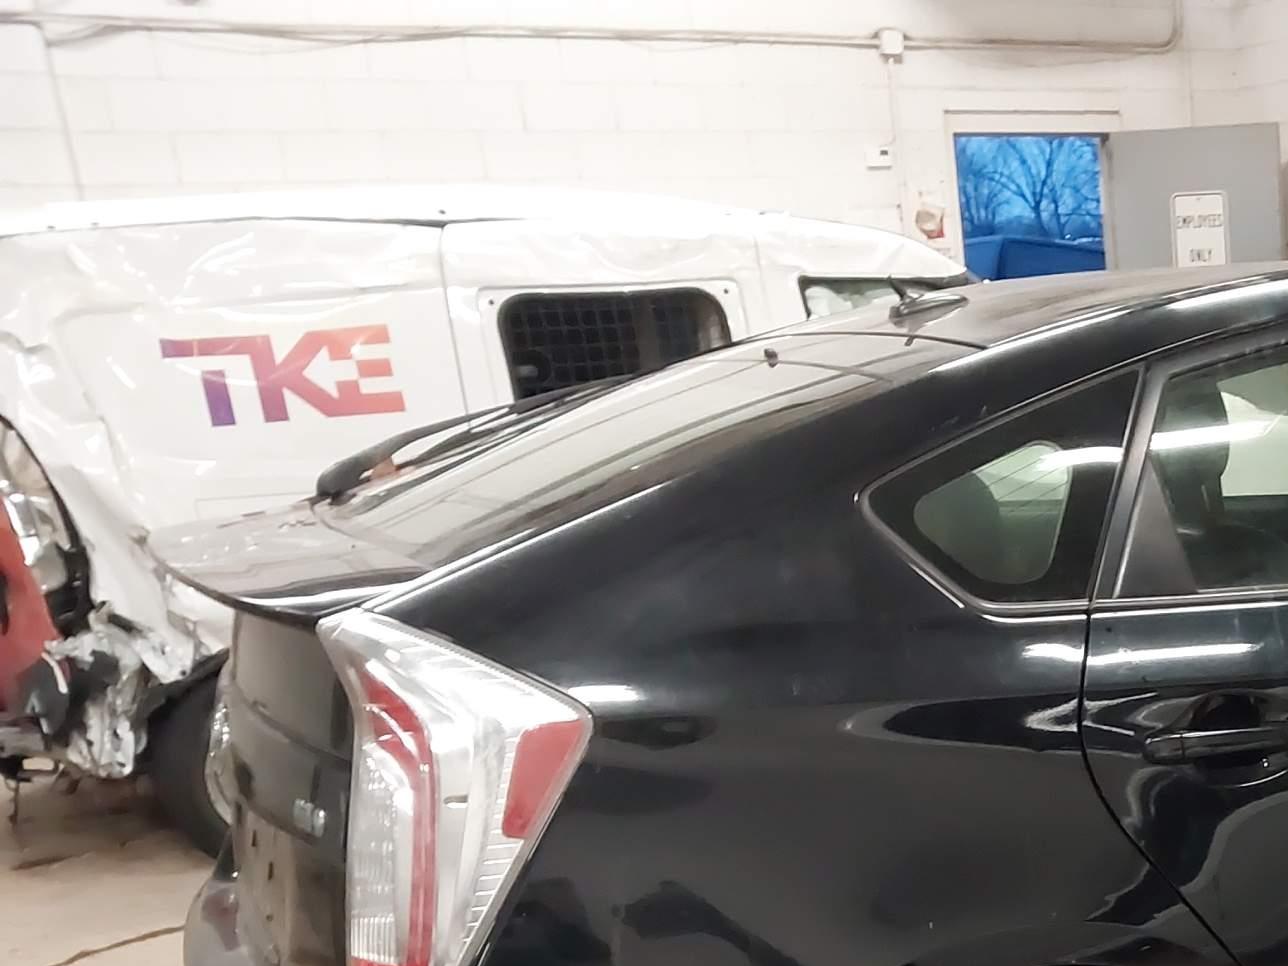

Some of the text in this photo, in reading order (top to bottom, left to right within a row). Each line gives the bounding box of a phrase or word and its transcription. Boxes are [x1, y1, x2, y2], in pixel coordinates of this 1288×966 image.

[1175, 213, 1223, 229] EMPLOYEES
[1189, 248, 1213, 263] ONLY
[159, 323, 406, 427] TKE
